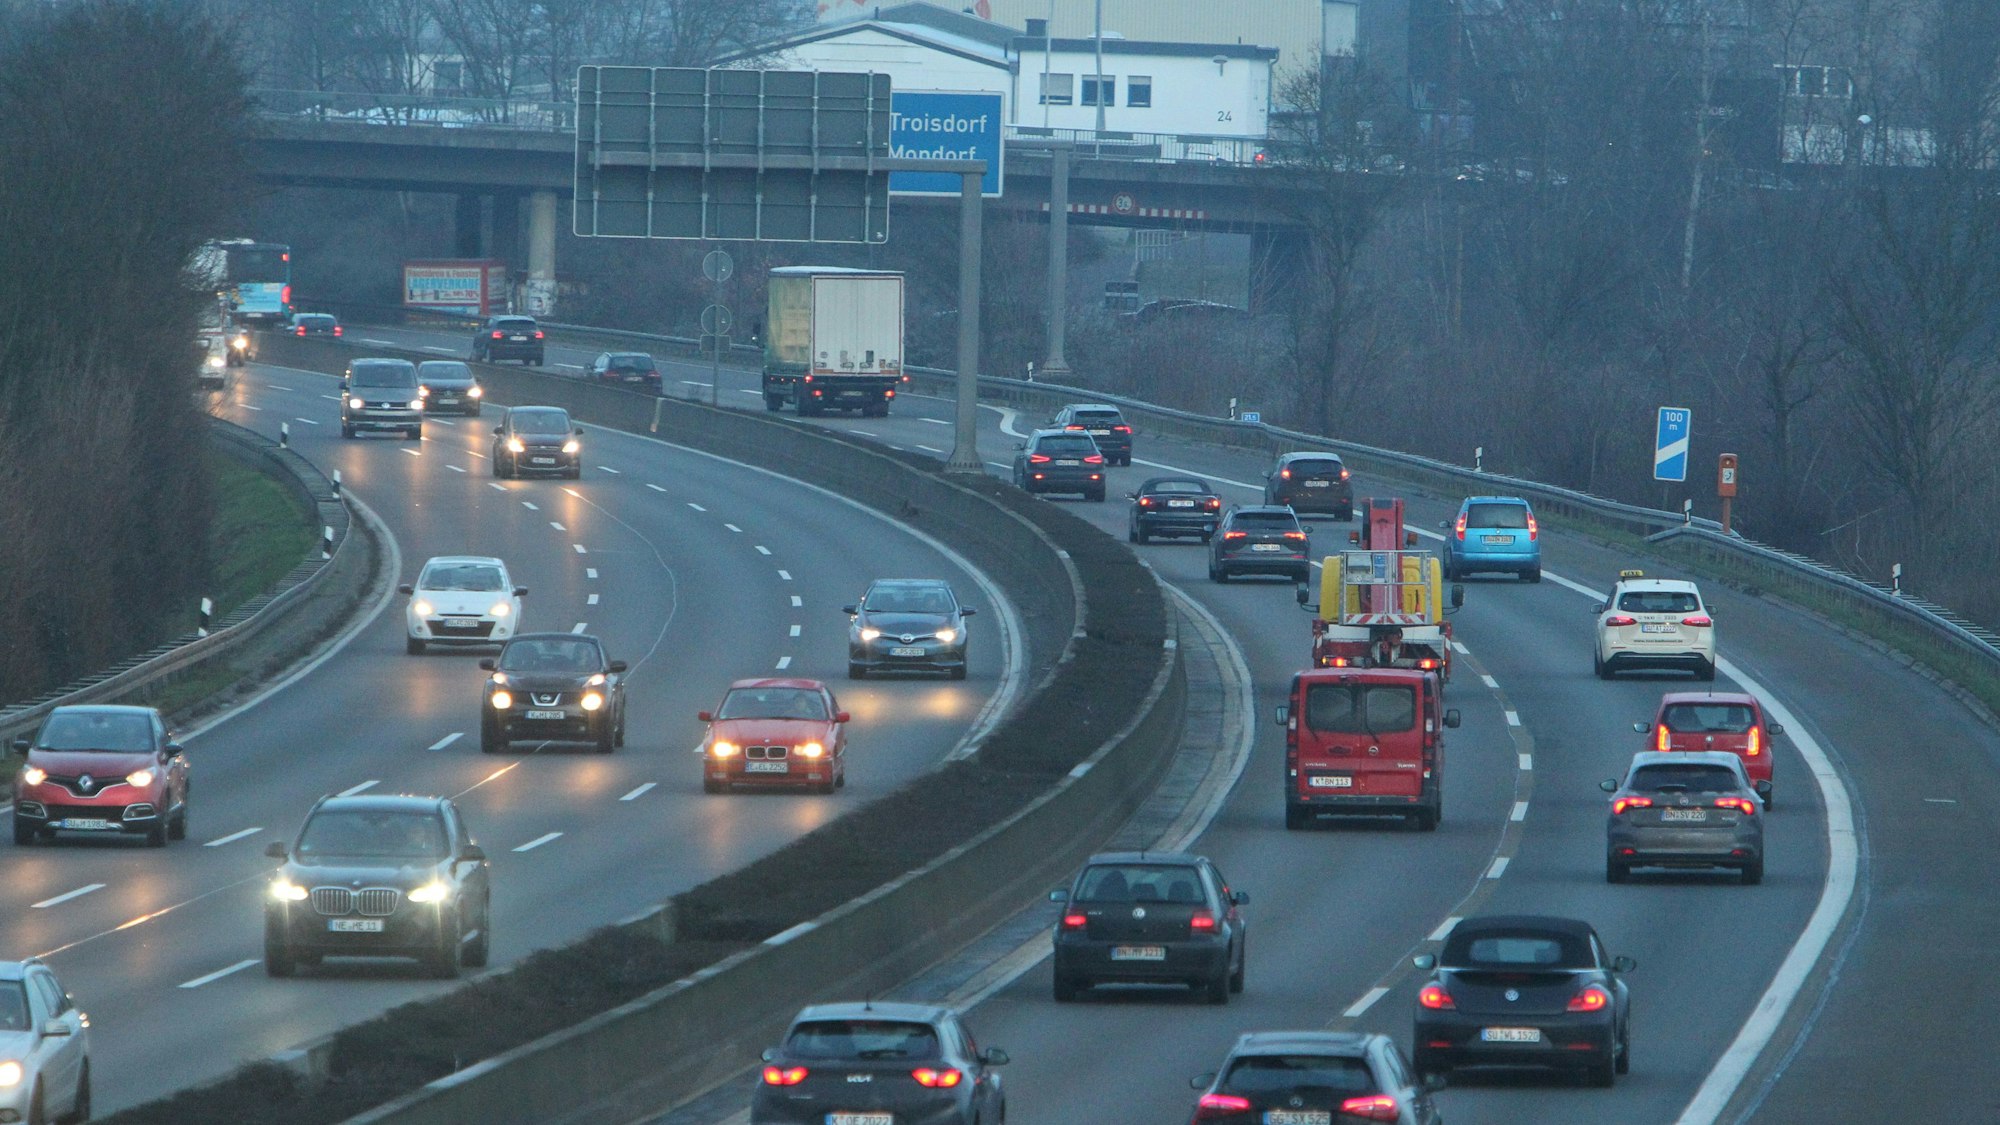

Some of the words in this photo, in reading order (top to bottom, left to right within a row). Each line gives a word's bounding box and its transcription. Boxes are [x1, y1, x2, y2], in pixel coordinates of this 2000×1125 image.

[1217, 110, 1232, 122] 24
[891, 113, 988, 133] Troisdorf
[888, 145, 978, 159] Mondorf
[1666, 412, 1683, 422] 100
